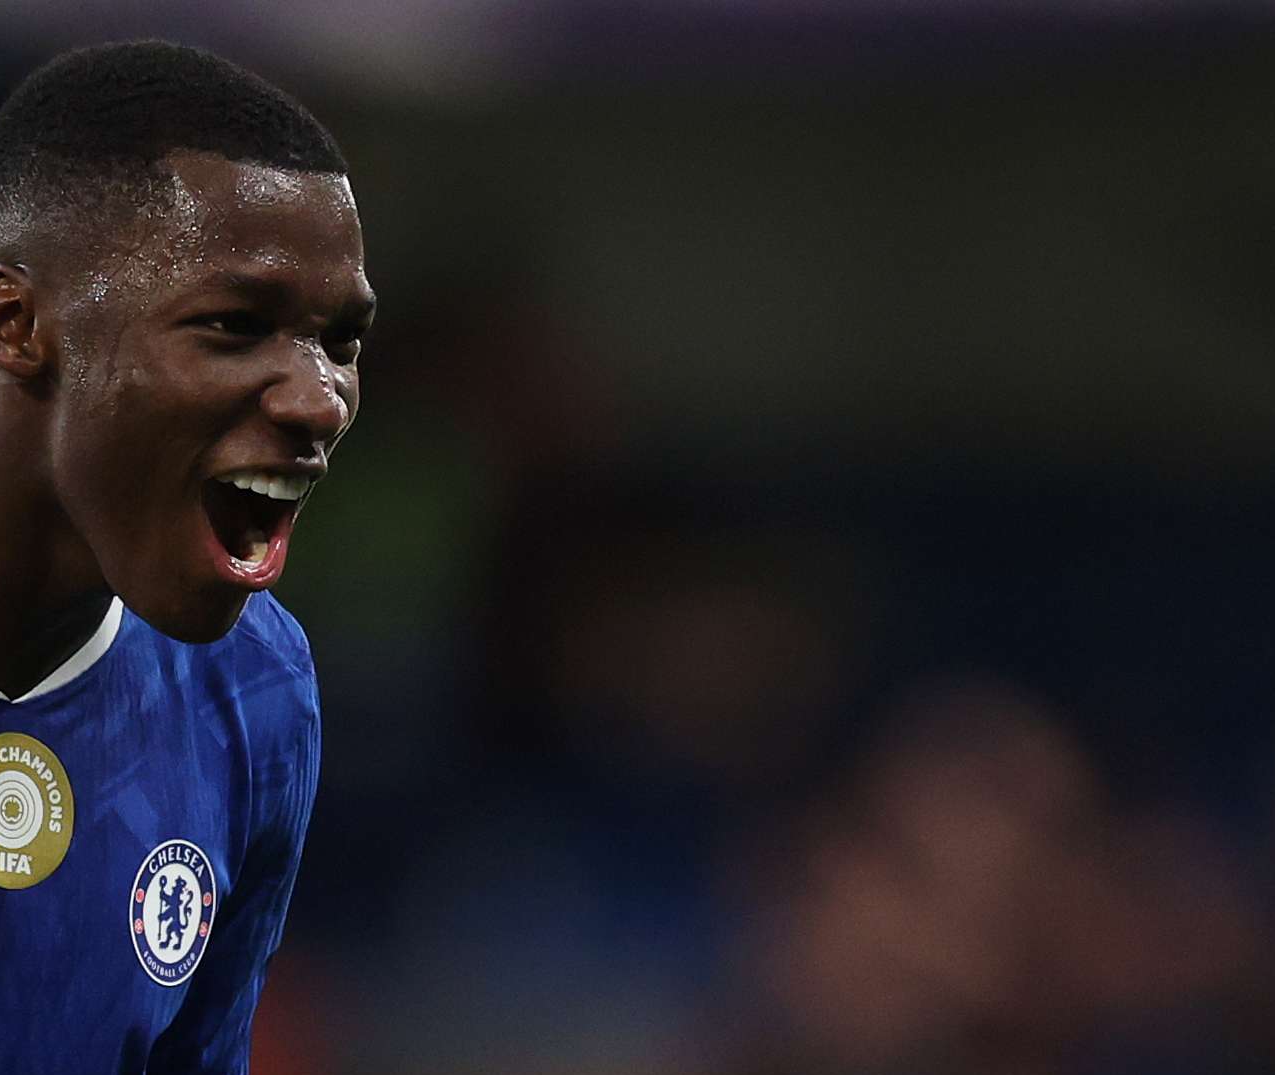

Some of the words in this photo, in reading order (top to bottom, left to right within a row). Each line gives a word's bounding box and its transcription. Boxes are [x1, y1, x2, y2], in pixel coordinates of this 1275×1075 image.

[148, 846, 204, 878] CHELSEA
[143, 951, 176, 977] FOOTBALL
[178, 952, 196, 974] CLUB
